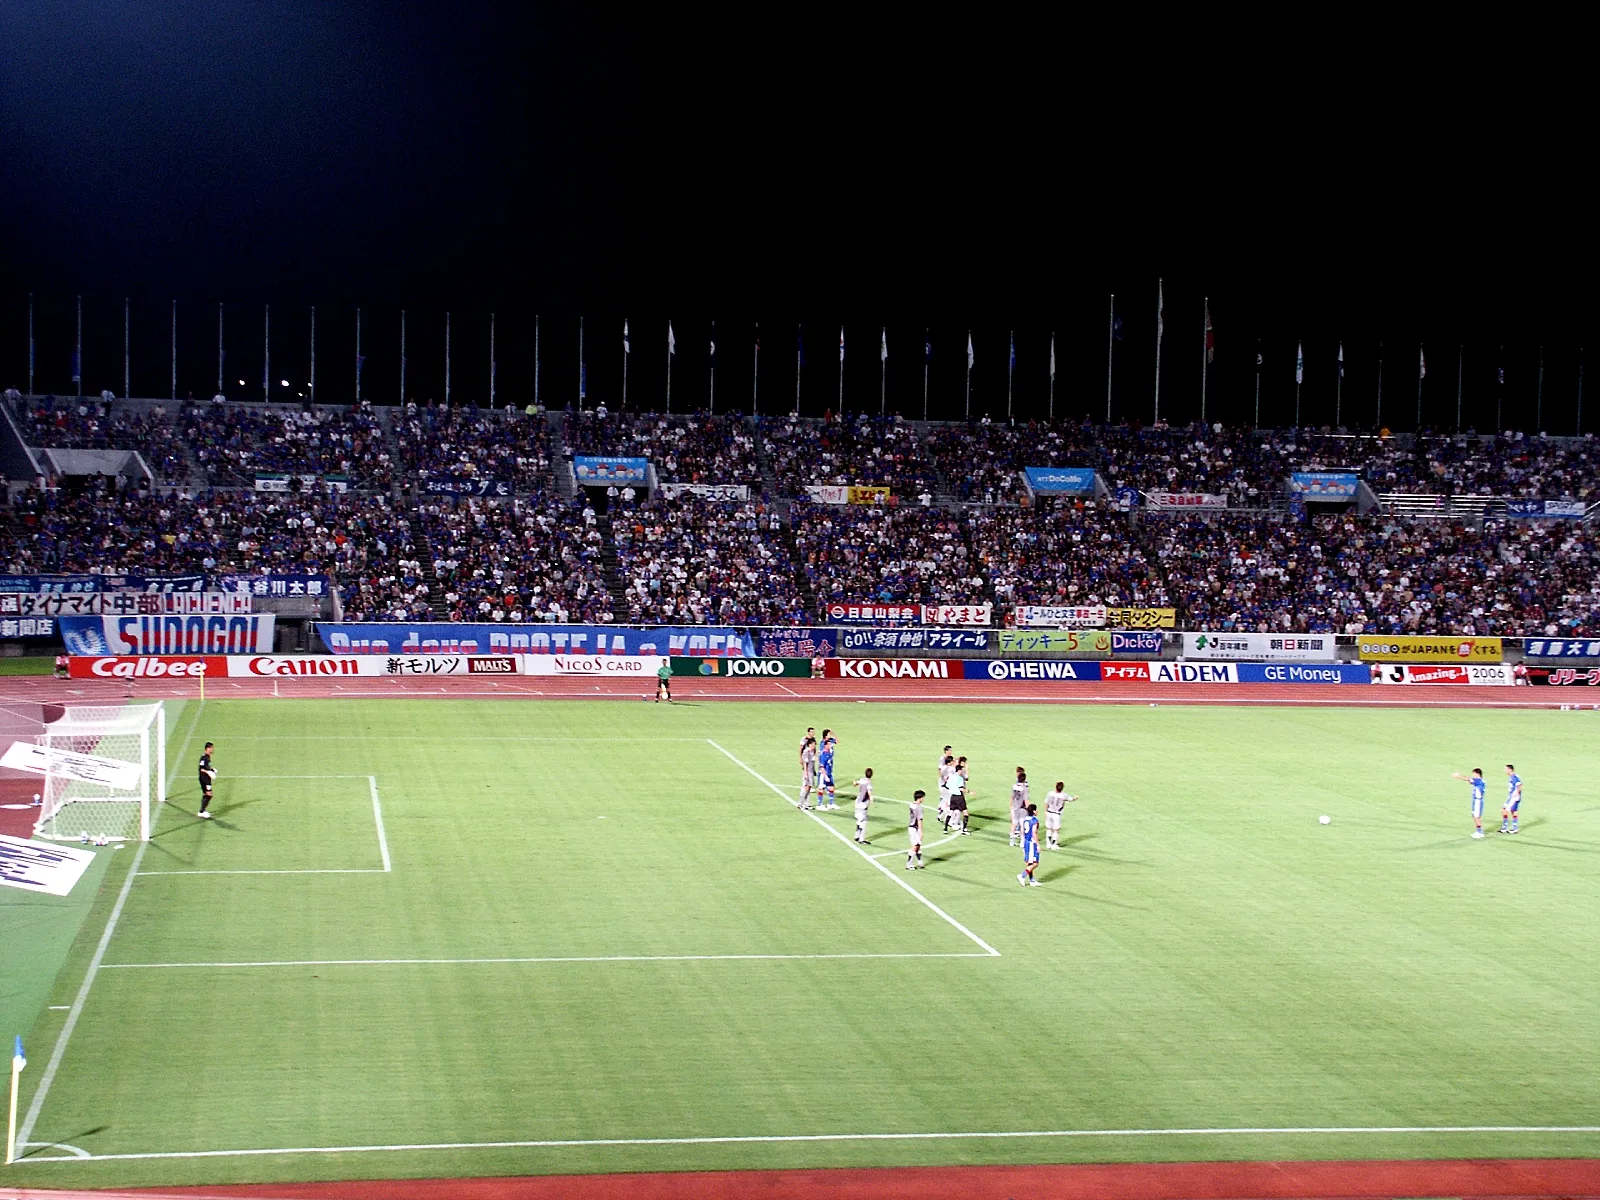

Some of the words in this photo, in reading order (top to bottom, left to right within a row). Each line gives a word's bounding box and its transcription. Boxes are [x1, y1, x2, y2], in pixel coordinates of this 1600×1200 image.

[929, 632, 987, 648] アライール
[1270, 639, 1323, 651] 朝日新聞
[91, 657, 207, 677] Calbee
[249, 656, 359, 676] Canon
[387, 657, 460, 674] 新モルツ
[607, 661, 642, 672] CARD
[726, 659, 784, 676] JOMO
[839, 659, 948, 678] KONAMI
[1009, 663, 1077, 679] HEIWA
[1104, 666, 1148, 679] アイテム
[1472, 667, 1505, 679] 2006
[1265, 666, 1290, 681] GE
[1293, 666, 1341, 684] Money
